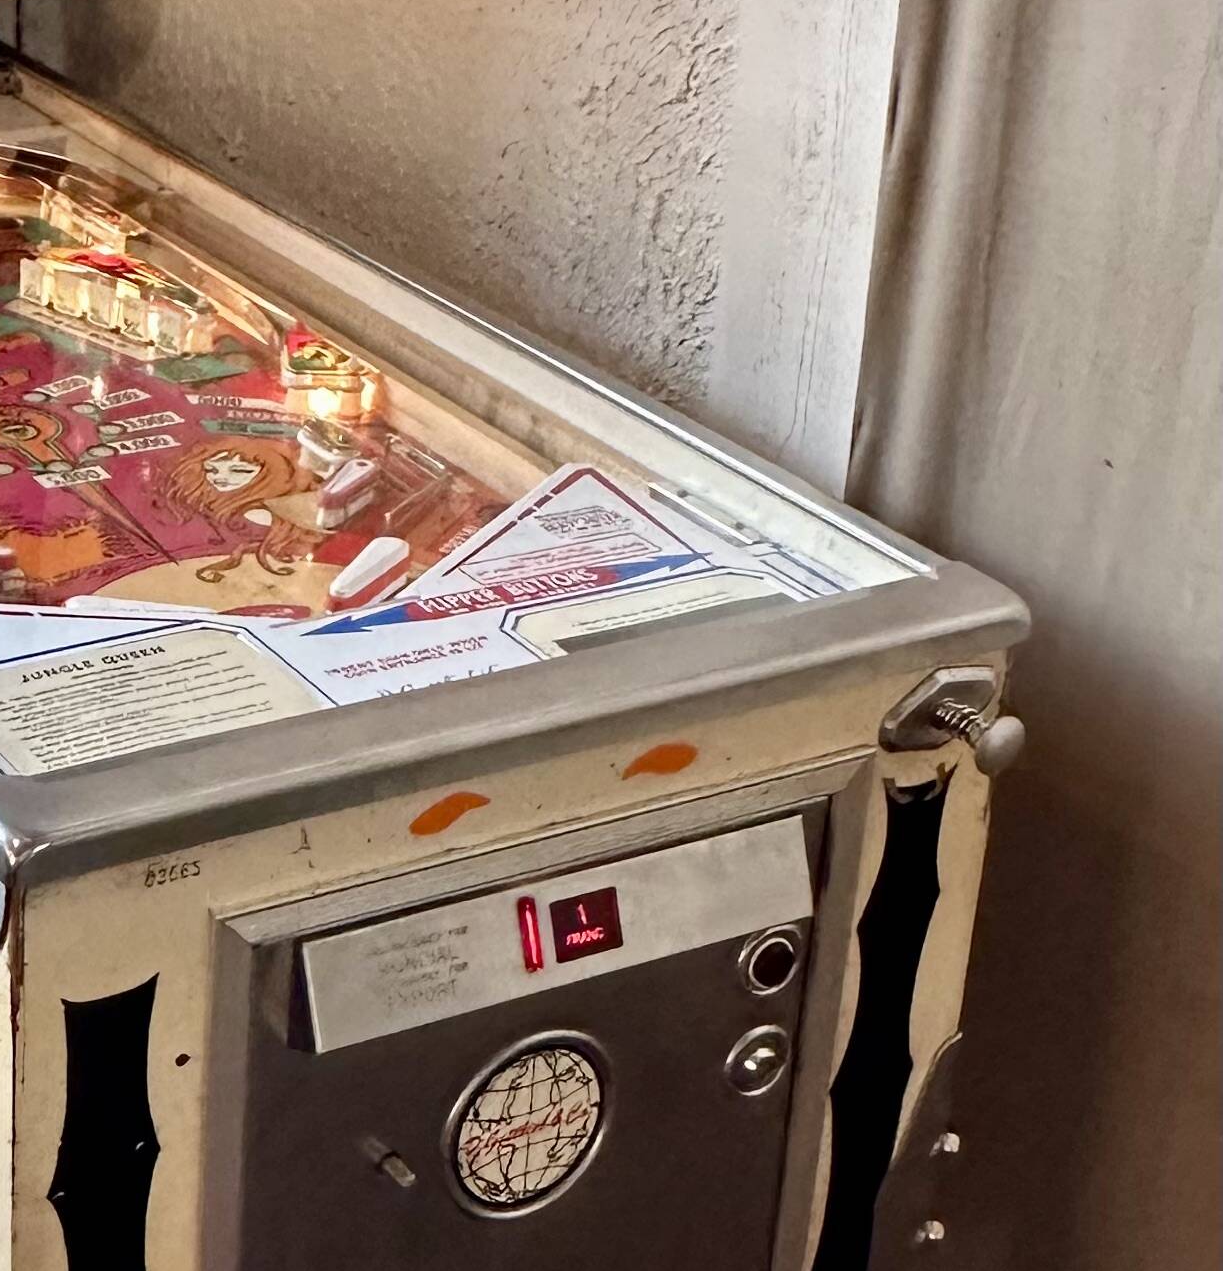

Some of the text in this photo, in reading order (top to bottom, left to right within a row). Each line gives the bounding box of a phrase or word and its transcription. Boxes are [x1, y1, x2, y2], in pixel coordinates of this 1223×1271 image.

[501, 567, 599, 596] BUTTONS
[20, 645, 167, 685] JUNGLE QUEEN
